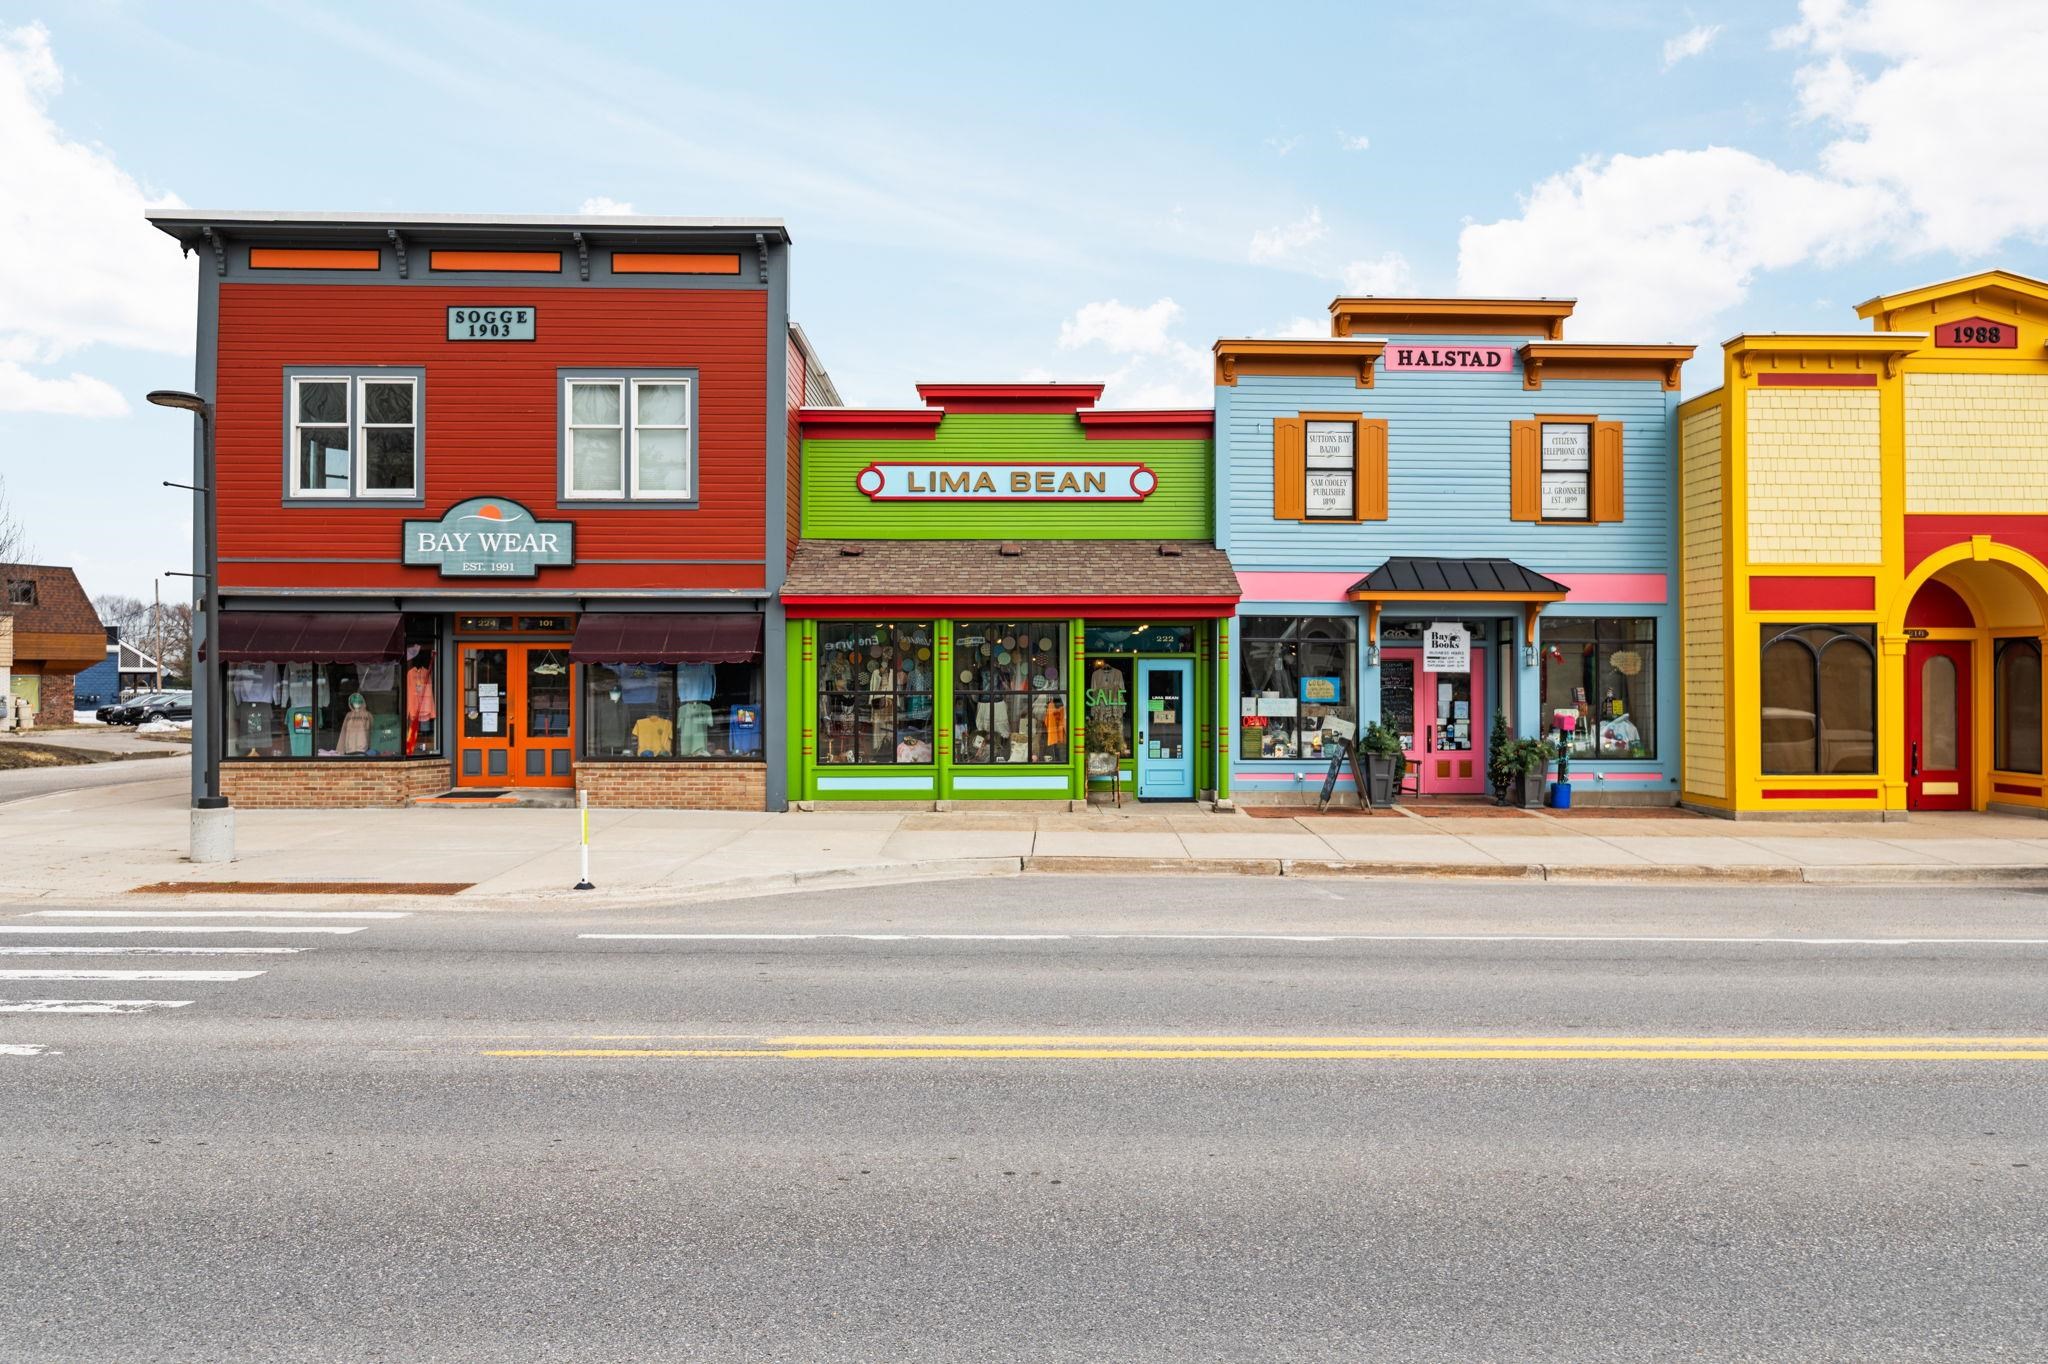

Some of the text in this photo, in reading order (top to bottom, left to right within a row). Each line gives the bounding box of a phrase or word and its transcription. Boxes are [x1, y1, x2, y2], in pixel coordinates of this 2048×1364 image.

[455, 310, 527, 324] SOGGE
[468, 324, 511, 337] 1903
[1953, 326, 2001, 344] 1988
[1397, 350, 1502, 368] HALSTAD
[1309, 434, 1351, 443] SUTTONS BAY
[1551, 437, 1578, 445] CITIZENS
[1319, 445, 1340, 454] BAZOO
[1543, 447, 1575, 456] TELEPHONE
[907, 471, 1106, 493] LIMA BEAN
[1310, 478, 1348, 487] SAM COOLEY
[1312, 488, 1346, 496] PUBLISHER
[1322, 497, 1336, 505] 1890
[1564, 496, 1578, 504] 1899
[417, 532, 559, 553] BAY WEAR
[462, 562, 515, 572] EST. 1991
[478, 619, 496, 627] 224
[539, 619, 553, 627] 101
[1431, 631, 1448, 643] Bay
[1431, 640, 1459, 649] Books
[1085, 688, 1127, 707] SALE
[1242, 715, 1267, 728] OPEN
